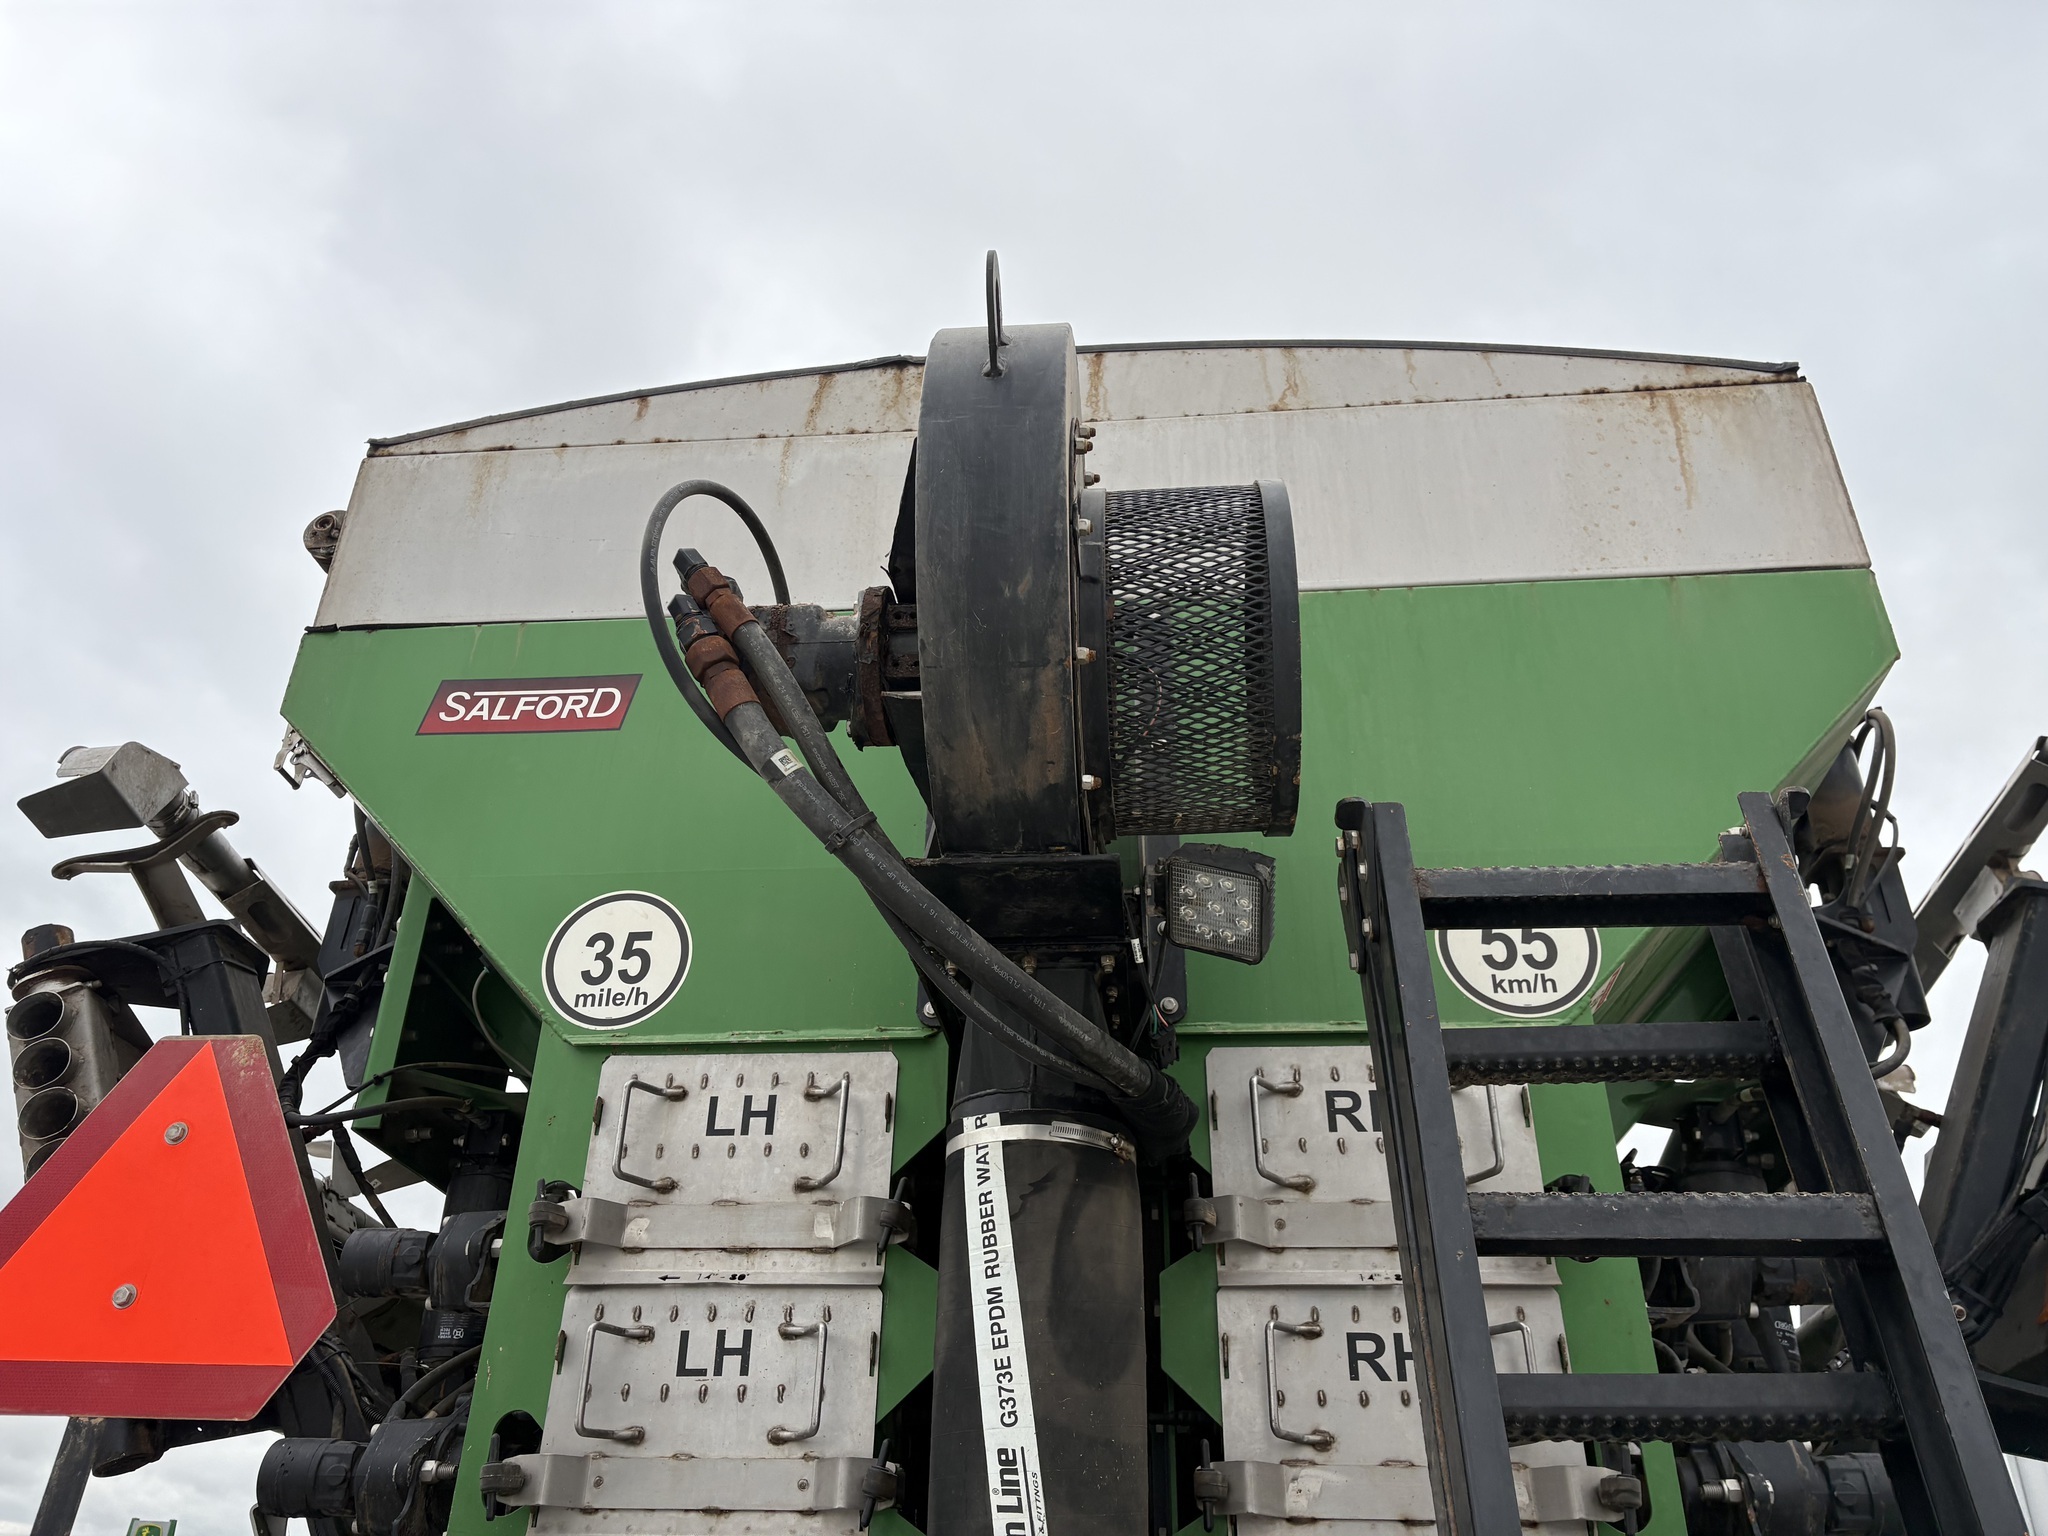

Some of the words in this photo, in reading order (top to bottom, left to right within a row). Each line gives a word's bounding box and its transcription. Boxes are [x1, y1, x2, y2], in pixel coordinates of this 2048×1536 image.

[438, 687, 622, 722] SALFORD
[864, 847, 876, 860] MPa
[877, 861, 887, 871] 21
[897, 880, 911, 894] MAX
[929, 908, 938, 919] 16
[946, 925, 978, 953] MINETUFF
[1481, 929, 1558, 971] 55
[580, 931, 653, 986] 35
[991, 962, 1021, 989] FLEXOPAK
[574, 987, 649, 1008] mile/h
[1028, 993, 1046, 1010] ITALY
[1491, 973, 1558, 994] km/h
[705, 1094, 777, 1137] LH
[1325, 1090, 1382, 1133] R
[975, 1114, 991, 1187] WATR
[979, 1190, 1001, 1279] RUBBER
[986, 1286, 1009, 1350] EPDM
[675, 1329, 752, 1378] LH
[994, 1356, 1018, 1428] G373E
[996, 1448, 1024, 1513] Line
